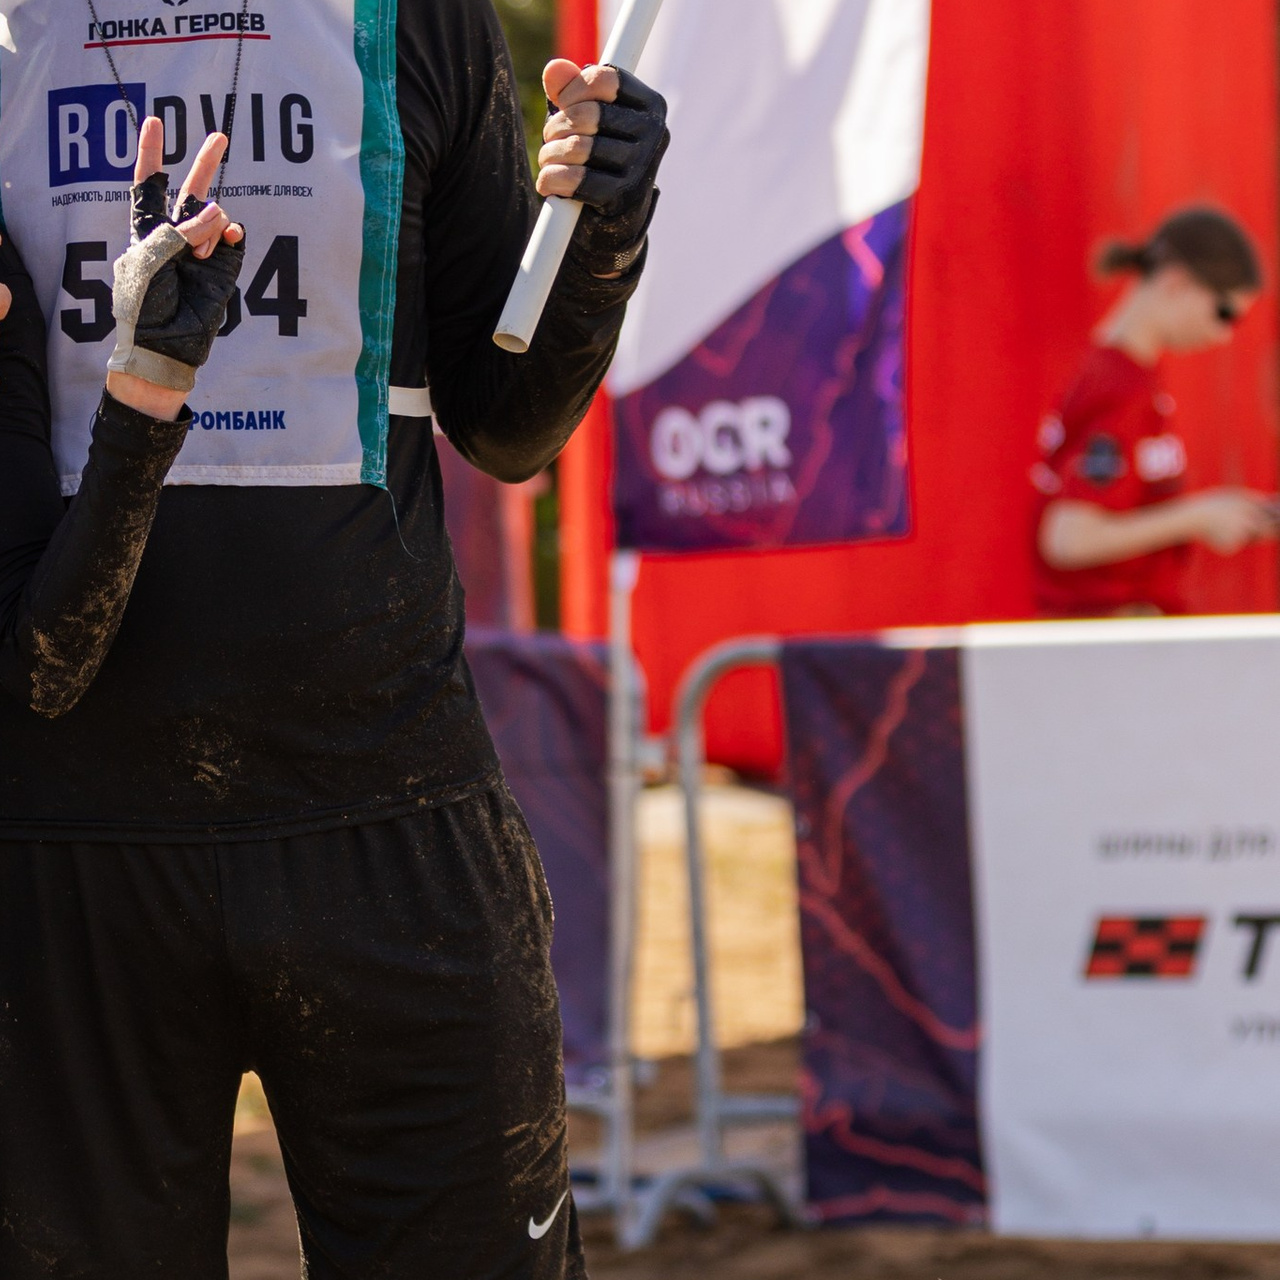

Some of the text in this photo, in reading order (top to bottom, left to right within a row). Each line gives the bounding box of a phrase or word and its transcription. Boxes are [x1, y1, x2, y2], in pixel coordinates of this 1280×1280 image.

[88, 12, 266, 41] ГОНКА ГЕРОЕВ
[58, 93, 315, 172] RODVIG
[51, 190, 103, 207] НАДЕЖНОСТЬ
[104, 189, 122, 202] ДЛЯ
[206, 185, 272, 199] ЛАГОСОСТОЯНИЕ
[273, 184, 292, 197] ДЛЯ
[292, 184, 313, 197] ВСЕХ
[60, 235, 308, 344] 54
[188, 410, 286, 430] РОМБАНК
[651, 396, 792, 480] OCR
